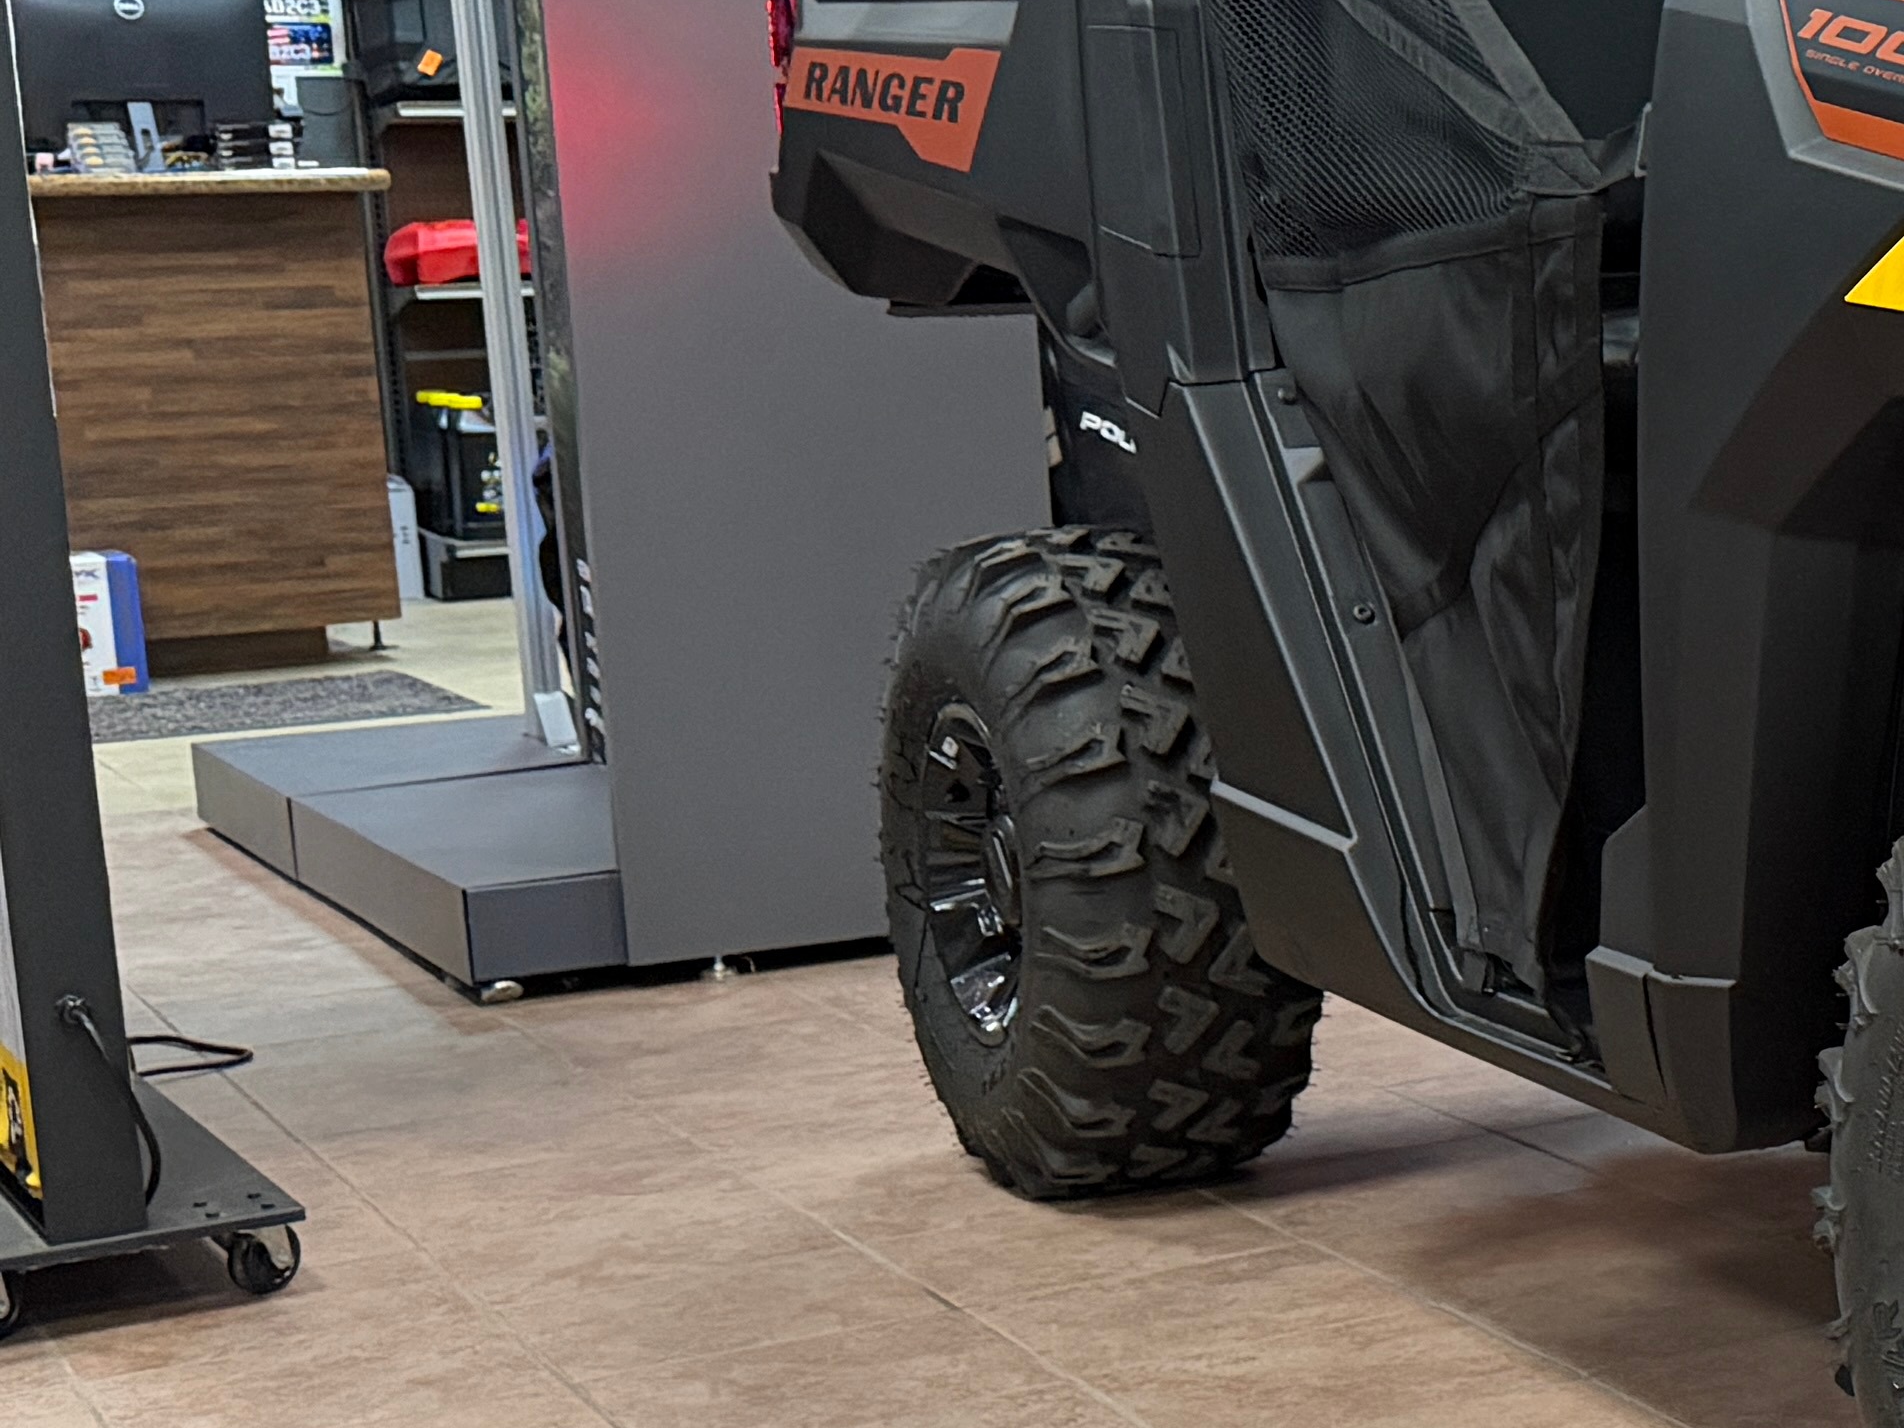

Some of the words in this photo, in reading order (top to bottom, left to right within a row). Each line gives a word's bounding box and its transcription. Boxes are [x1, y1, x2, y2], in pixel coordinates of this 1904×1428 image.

[1806, 48, 1860, 71] SINGLE
[804, 61, 965, 123] RANGER
[1080, 411, 1137, 454] POL
